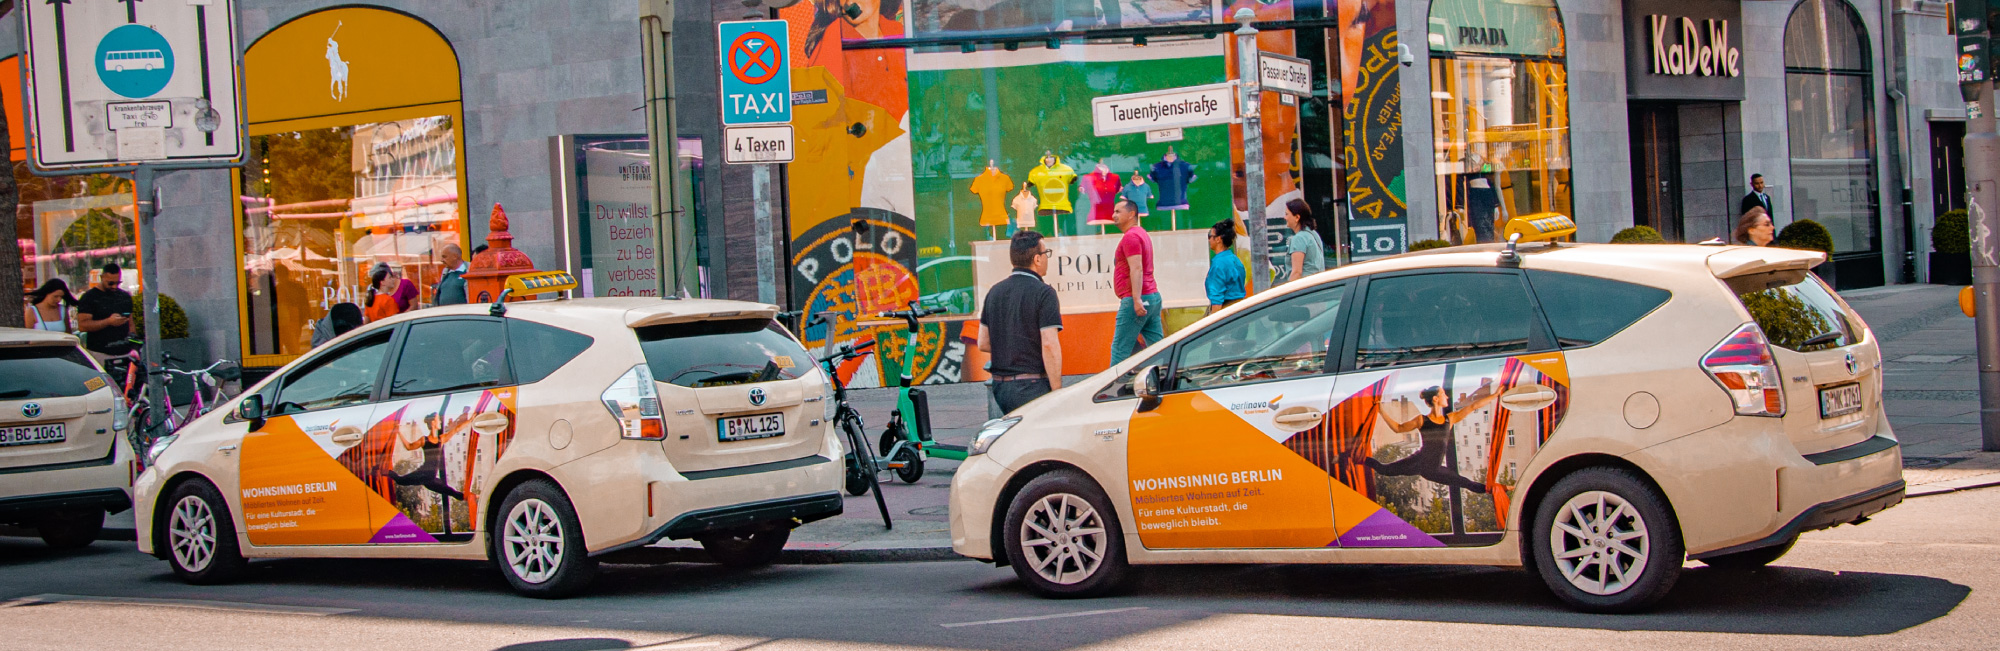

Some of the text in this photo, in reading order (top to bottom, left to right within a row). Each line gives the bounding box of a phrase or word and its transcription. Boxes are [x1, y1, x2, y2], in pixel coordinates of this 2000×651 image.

[1458, 26, 1508, 46] PRADA
[1651, 14, 1739, 77] KaDeWe
[1263, 61, 1307, 88] Passauer Straße
[729, 92, 784, 115] TAXI
[734, 136, 785, 152] 4 Taxen
[596, 203, 649, 220] Du willst
[1531, 215, 1570, 232] TAXI
[617, 249, 631, 261] zu
[798, 231, 903, 284] POLO
[1058, 253, 1117, 276] POL
[525, 273, 569, 288] TAXI
[1231, 401, 1267, 410] berlinovo
[0, 425, 63, 441] B BC 1061
[729, 415, 779, 435] B XL 125
[1133, 468, 1282, 491] WOHNSINNIG BERLIN
[242, 481, 337, 499] WOHNSINNIG BERLIN
[1135, 487, 1265, 505] Möbliertes Wohnen auf Zeit.
[244, 500, 276, 509] Möbliertes
[277, 499, 300, 507] Wohnen
[1138, 502, 1248, 517] Für eine Kulturstadt, die
[246, 512, 256, 520] Für
[270, 509, 305, 518] Kulturstadt,
[306, 508, 316, 516] die
[248, 520, 299, 531] beweglich bleibt.
[1141, 516, 1222, 531] beweglich bleibt.
[1356, 533, 1408, 541] www.berlinovo.de
